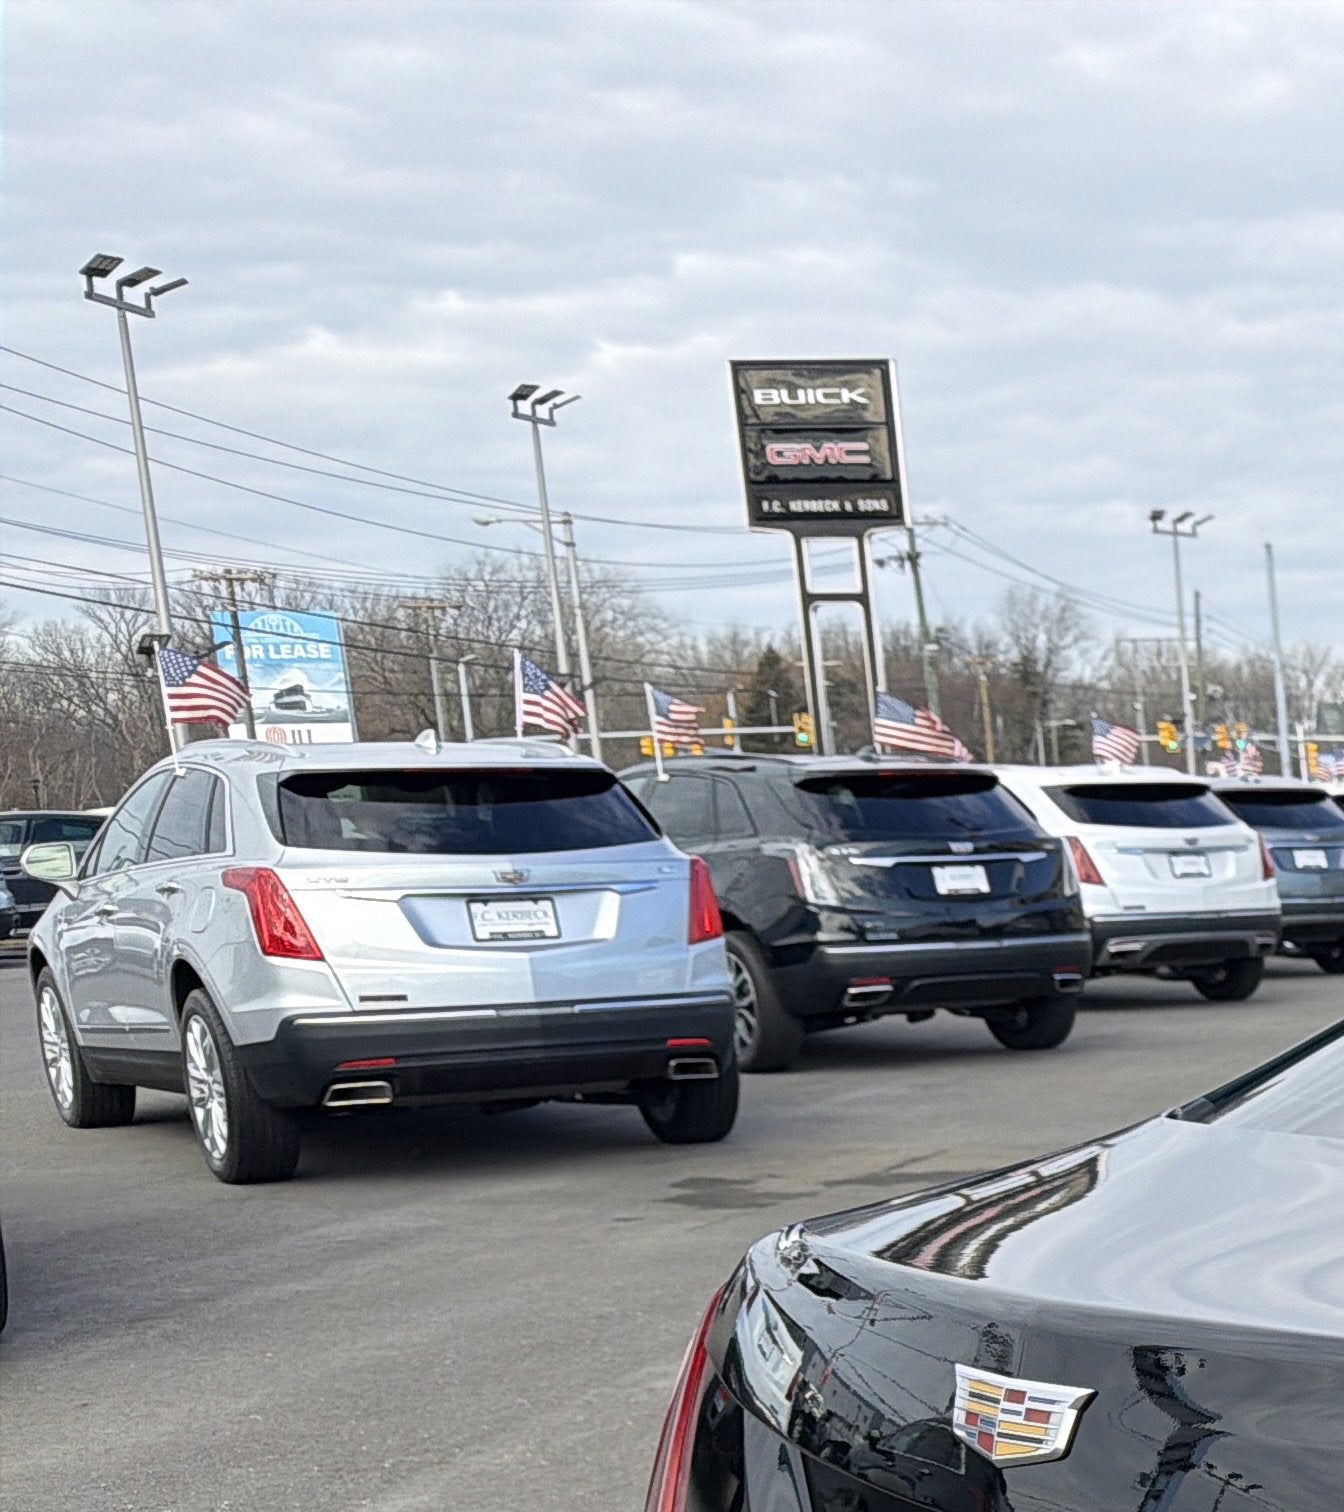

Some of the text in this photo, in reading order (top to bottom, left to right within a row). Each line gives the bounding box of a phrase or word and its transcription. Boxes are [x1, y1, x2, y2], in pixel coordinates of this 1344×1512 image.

[753, 388, 870, 404] BUICK
[766, 442, 870, 465] GMC
[268, 643, 332, 659] LEASE
